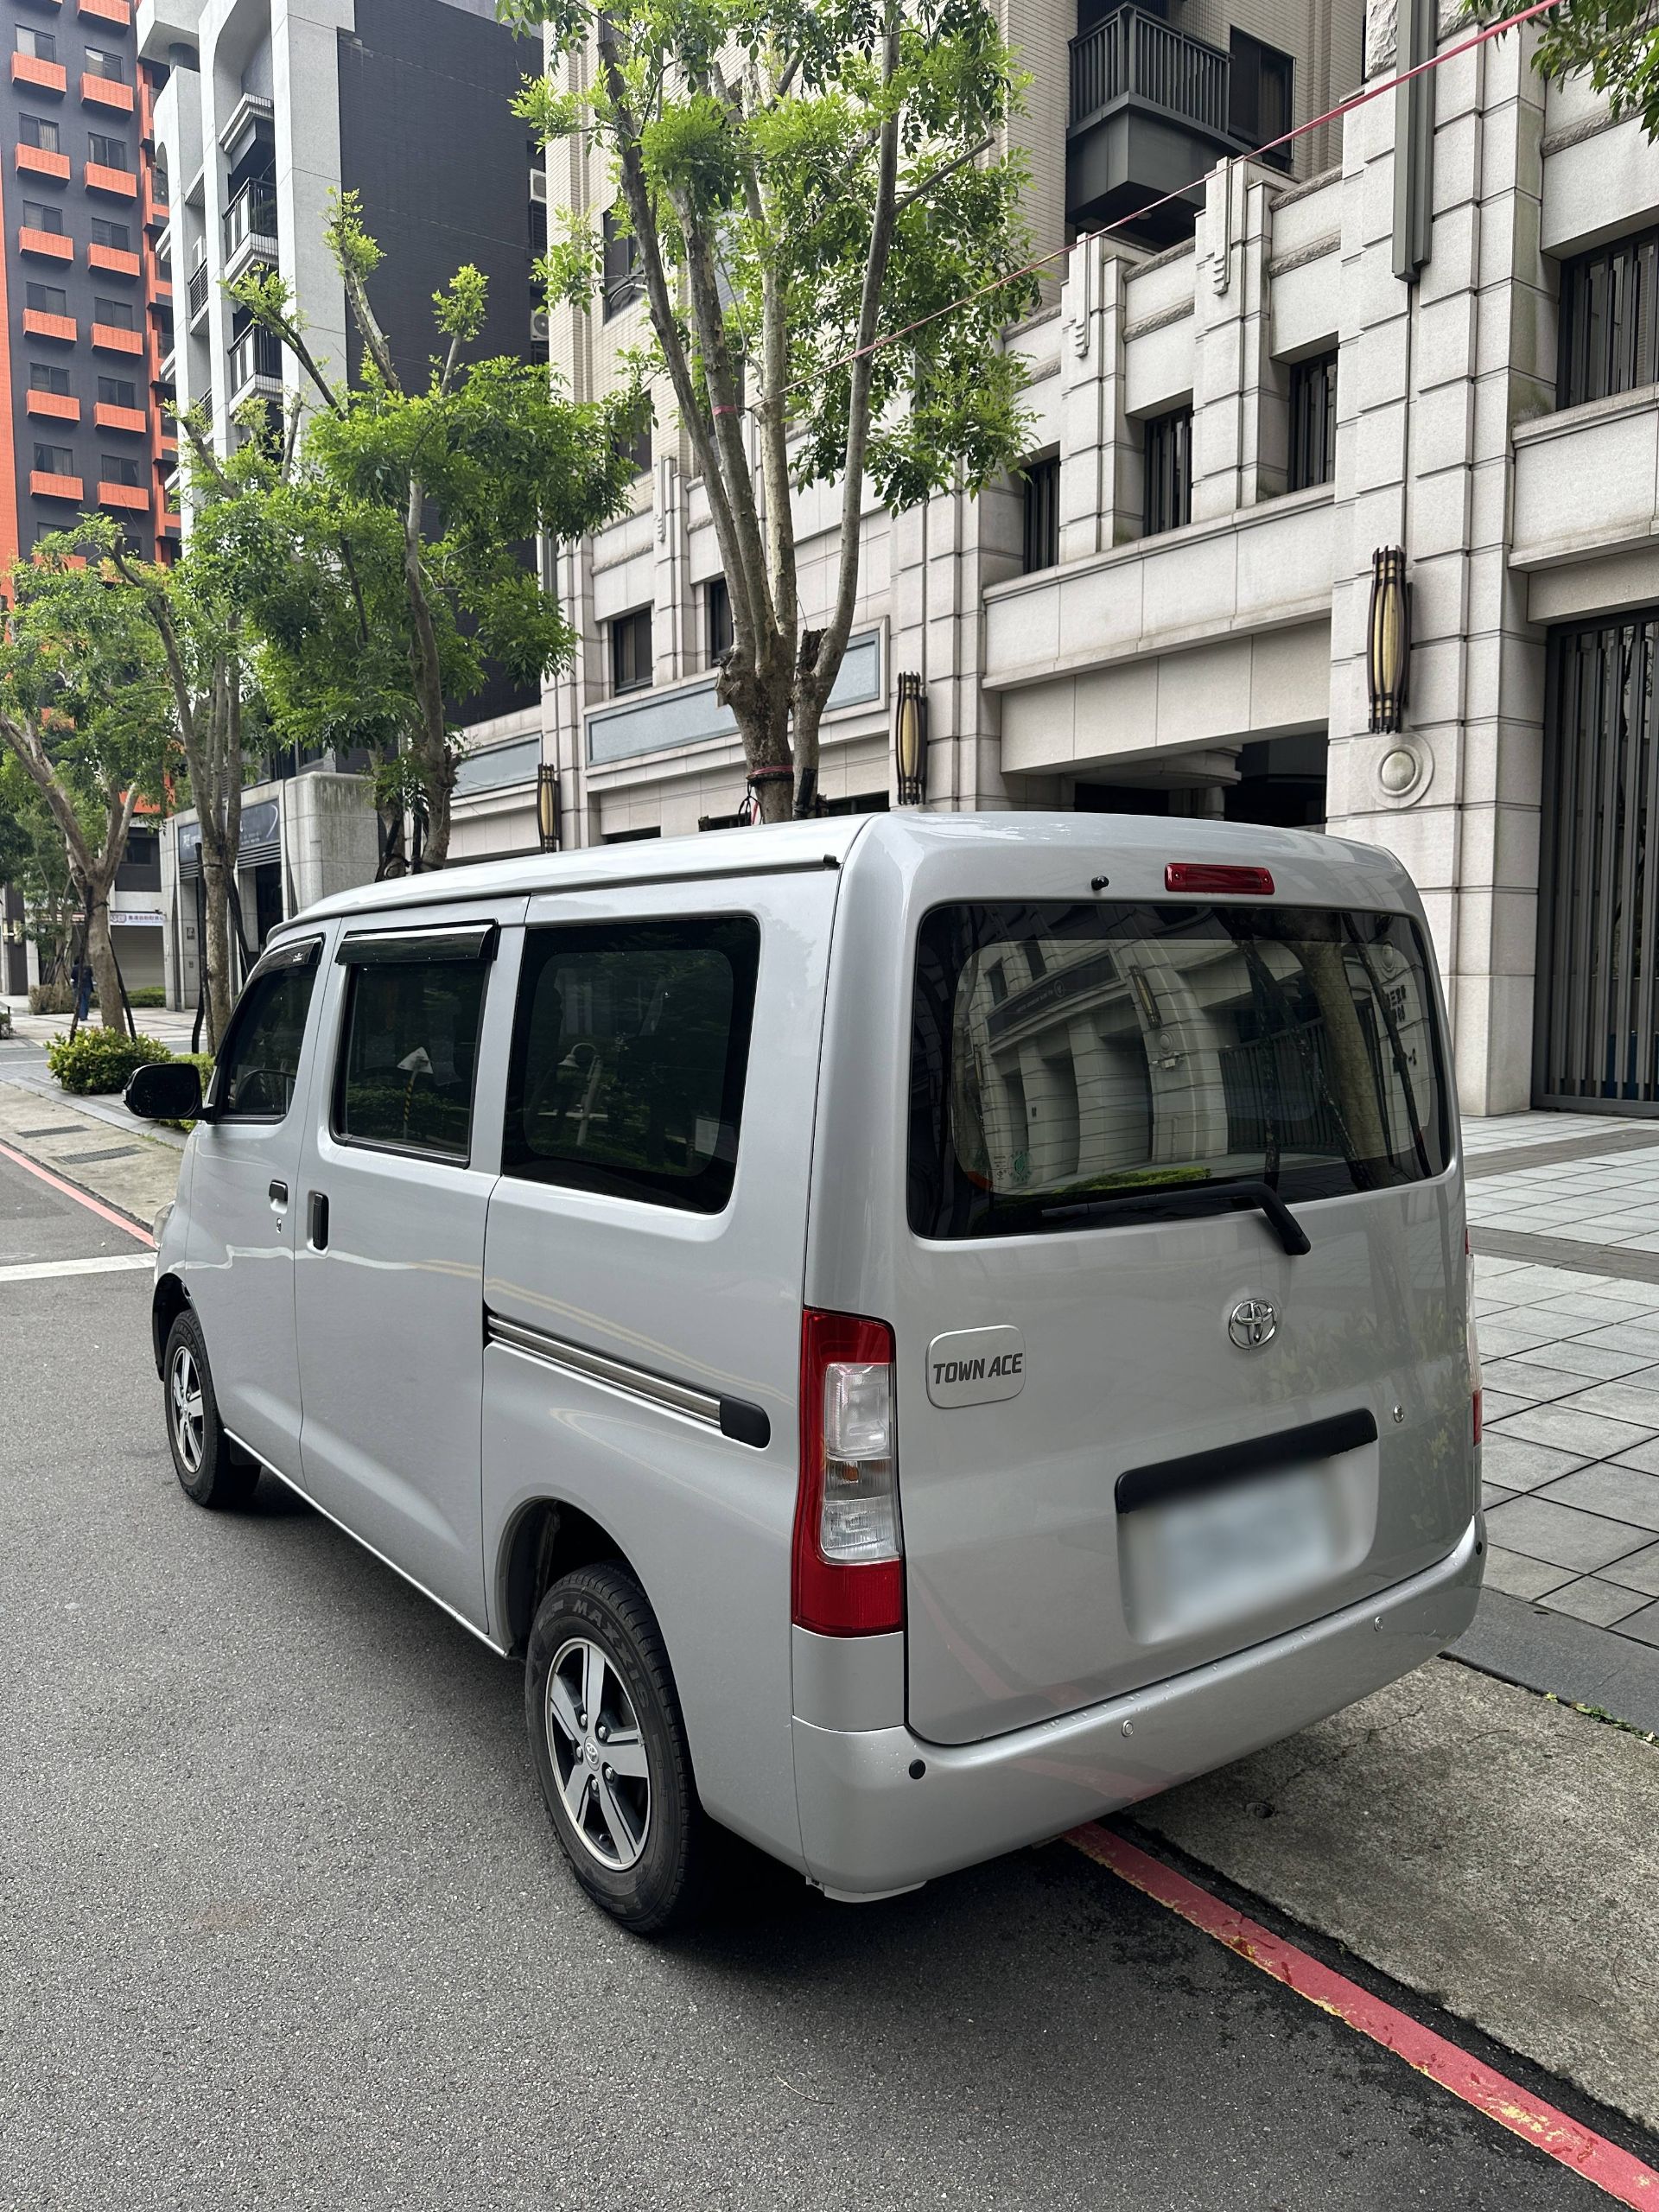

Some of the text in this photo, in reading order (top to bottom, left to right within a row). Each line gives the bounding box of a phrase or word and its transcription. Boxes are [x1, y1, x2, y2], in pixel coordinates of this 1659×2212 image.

[933, 1352, 1023, 1384] TOWN ACE
[572, 1599, 649, 1708] MAXXIS
